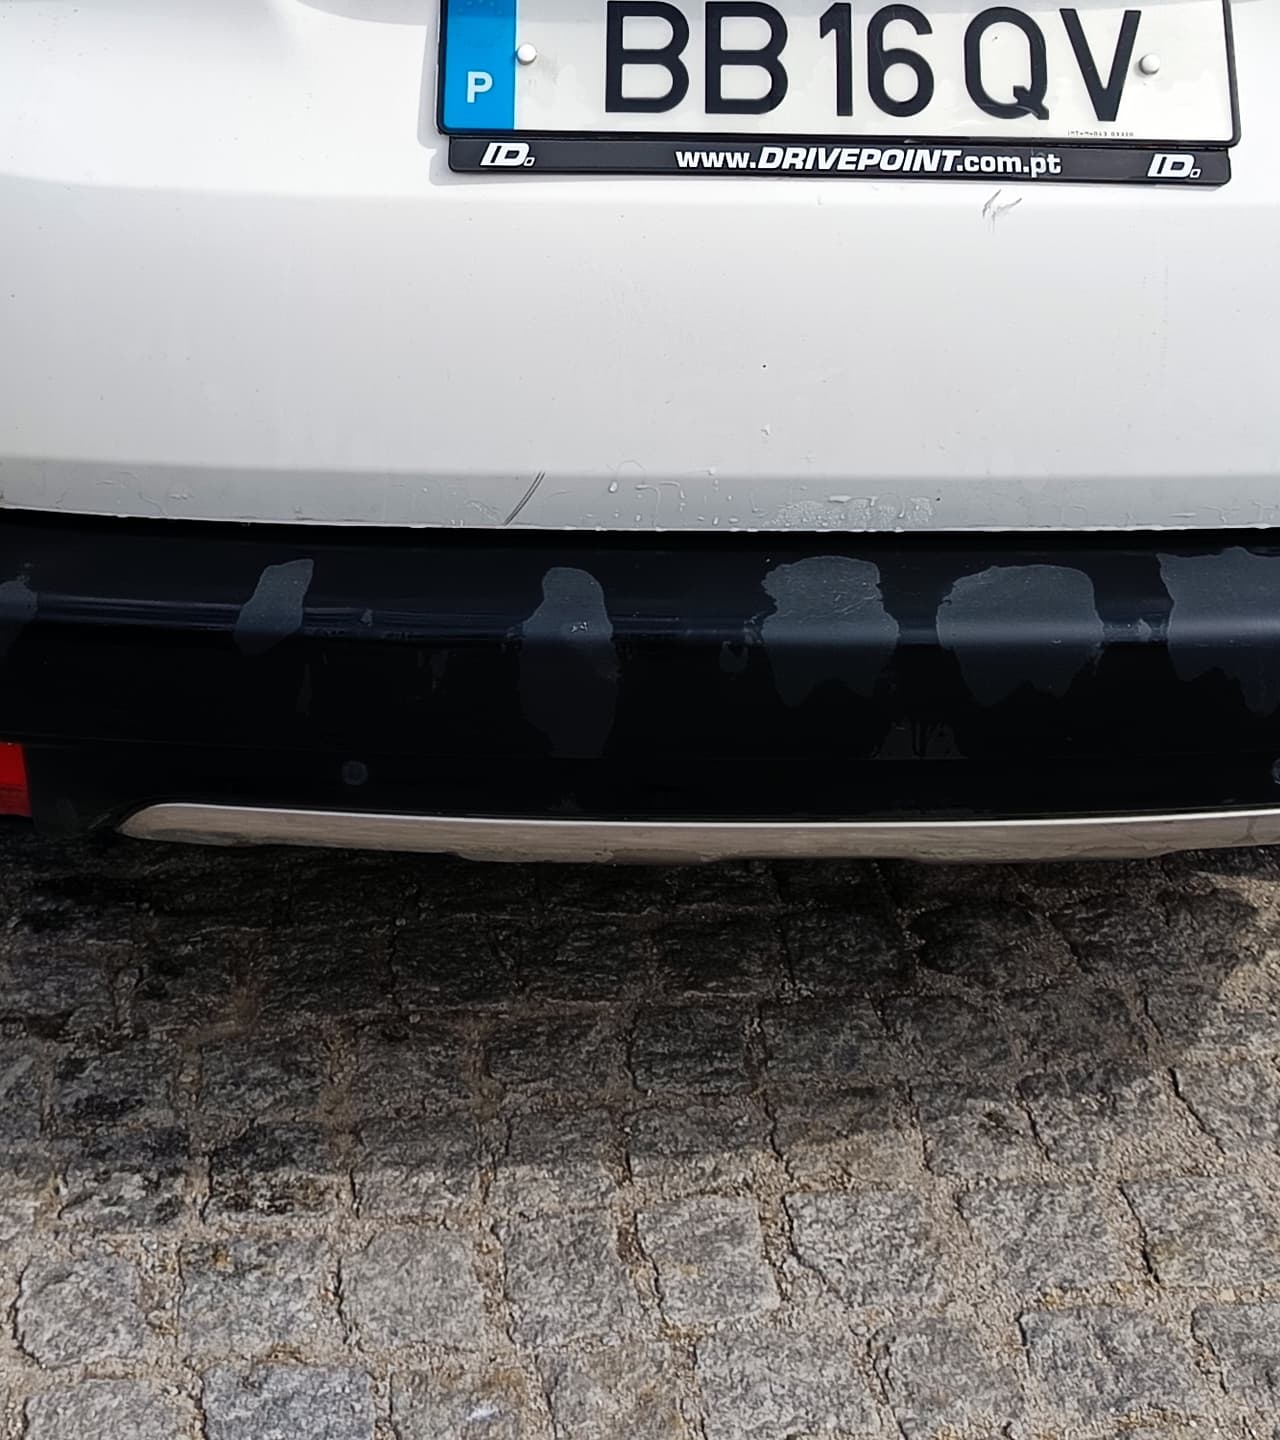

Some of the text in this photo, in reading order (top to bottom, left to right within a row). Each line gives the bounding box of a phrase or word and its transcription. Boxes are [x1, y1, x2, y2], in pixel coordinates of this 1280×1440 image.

[605, 0, 1142, 122] BB 16 QV
[466, 70, 494, 104] P
[675, 148, 1062, 178] www.DRIVEPOINT.com.pt
